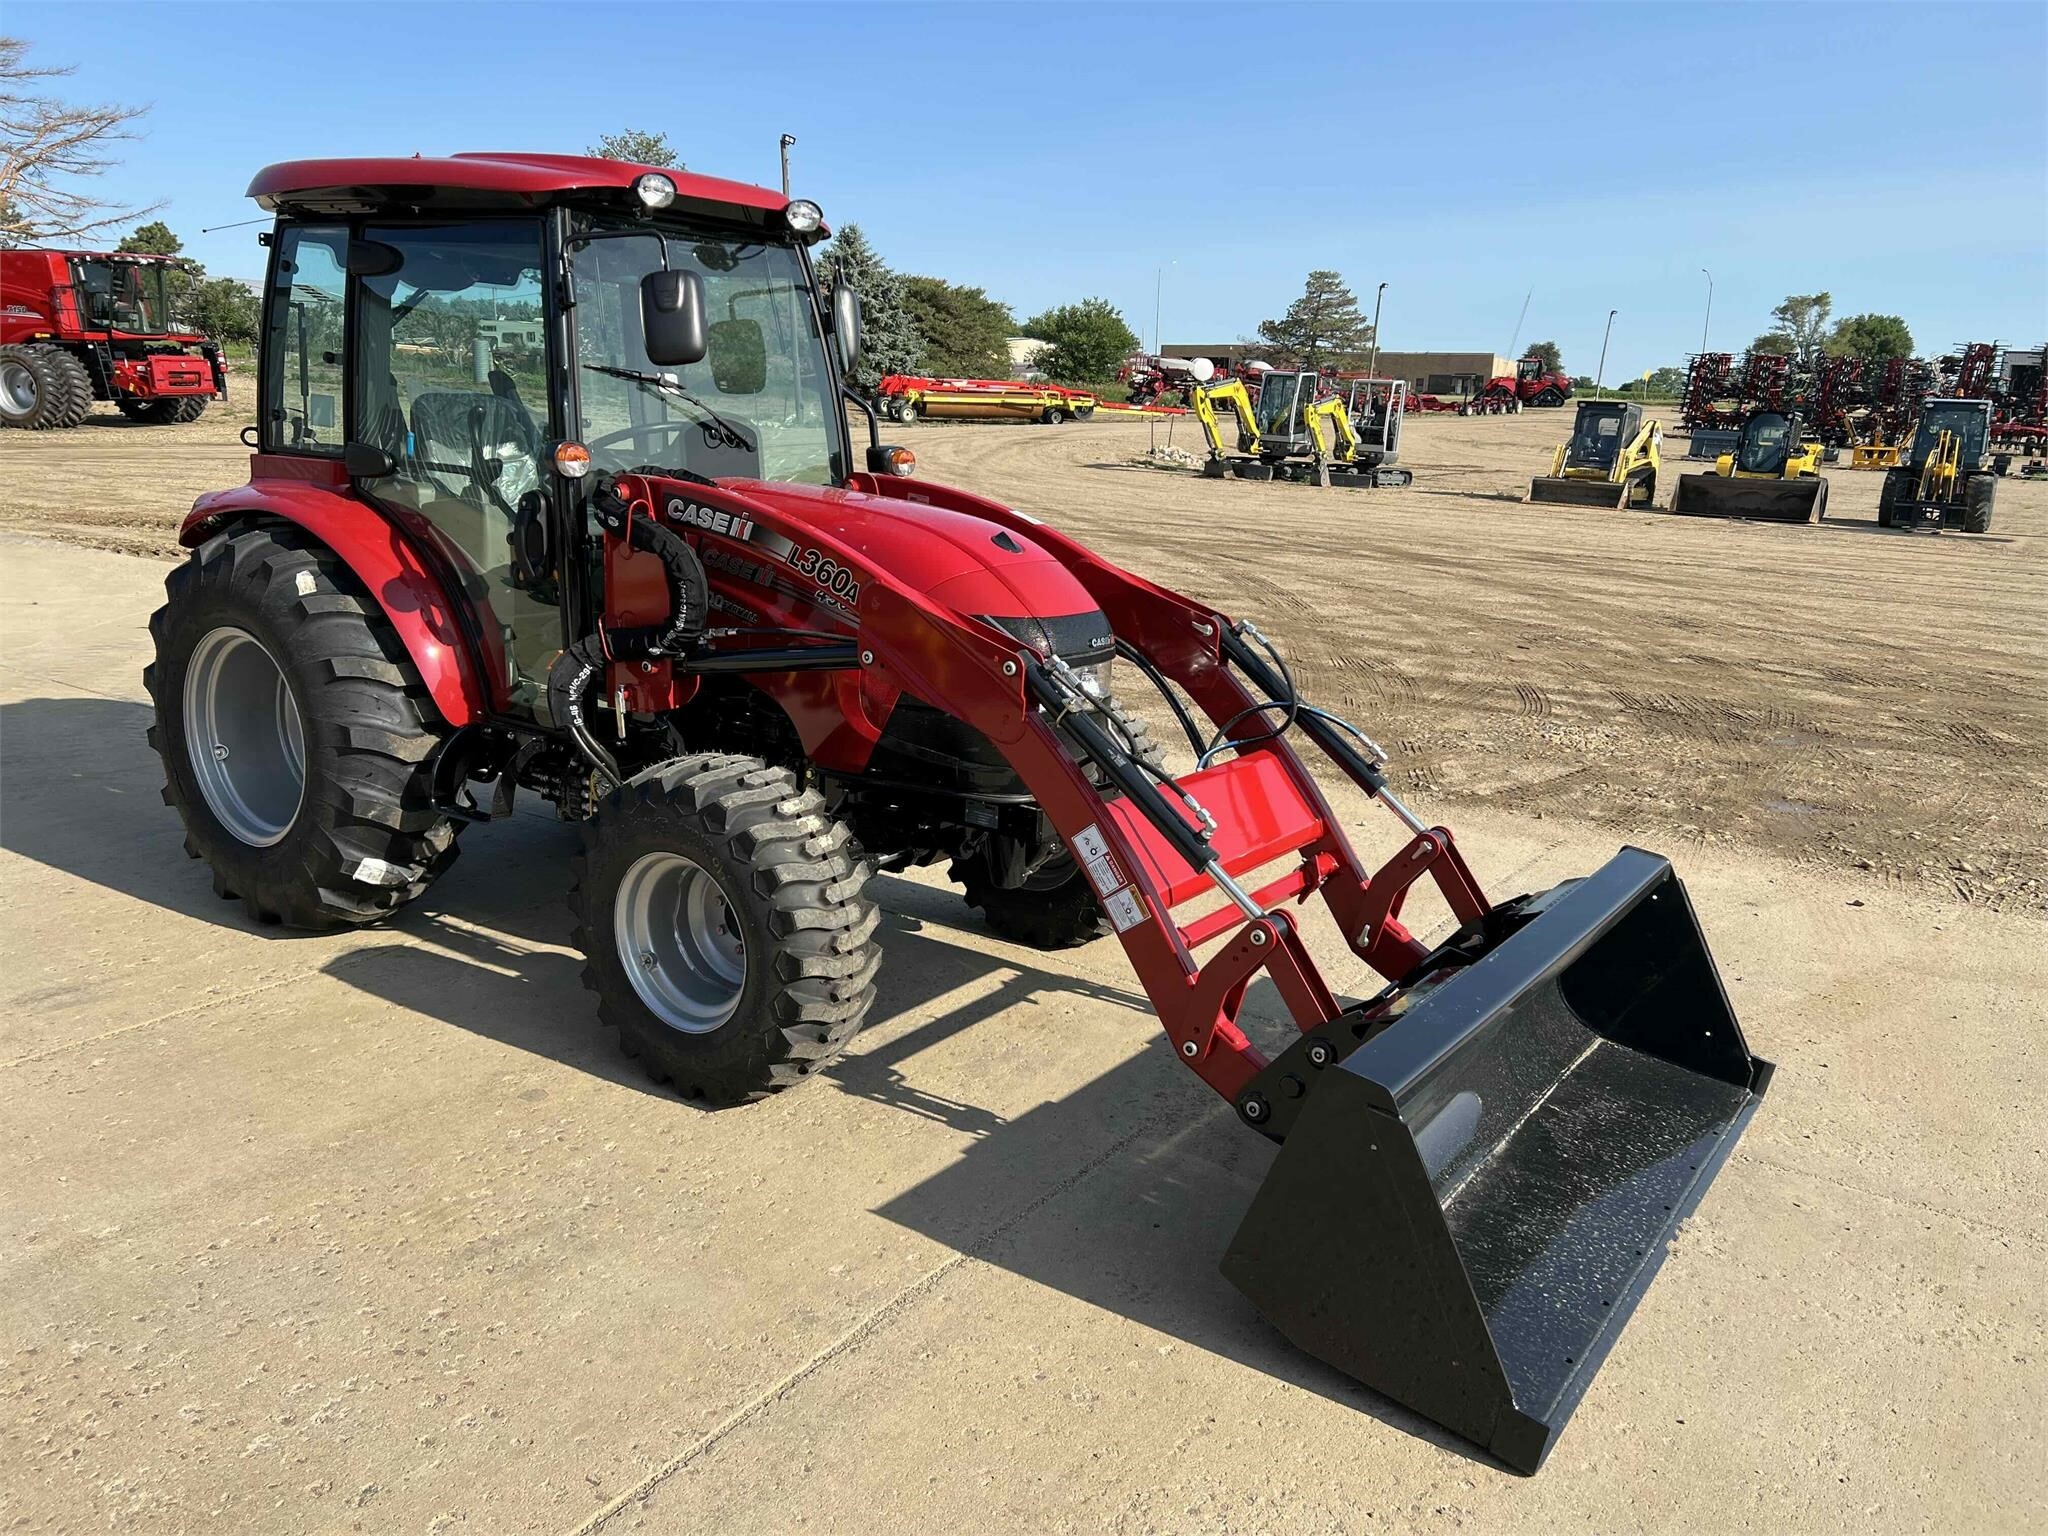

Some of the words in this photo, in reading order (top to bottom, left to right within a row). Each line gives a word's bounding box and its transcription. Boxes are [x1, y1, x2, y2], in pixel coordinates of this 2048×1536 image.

[6, 304, 28, 313] 7150
[667, 499, 731, 533] CASE
[701, 548, 755, 581] CASE
[786, 545, 861, 604] L360A
